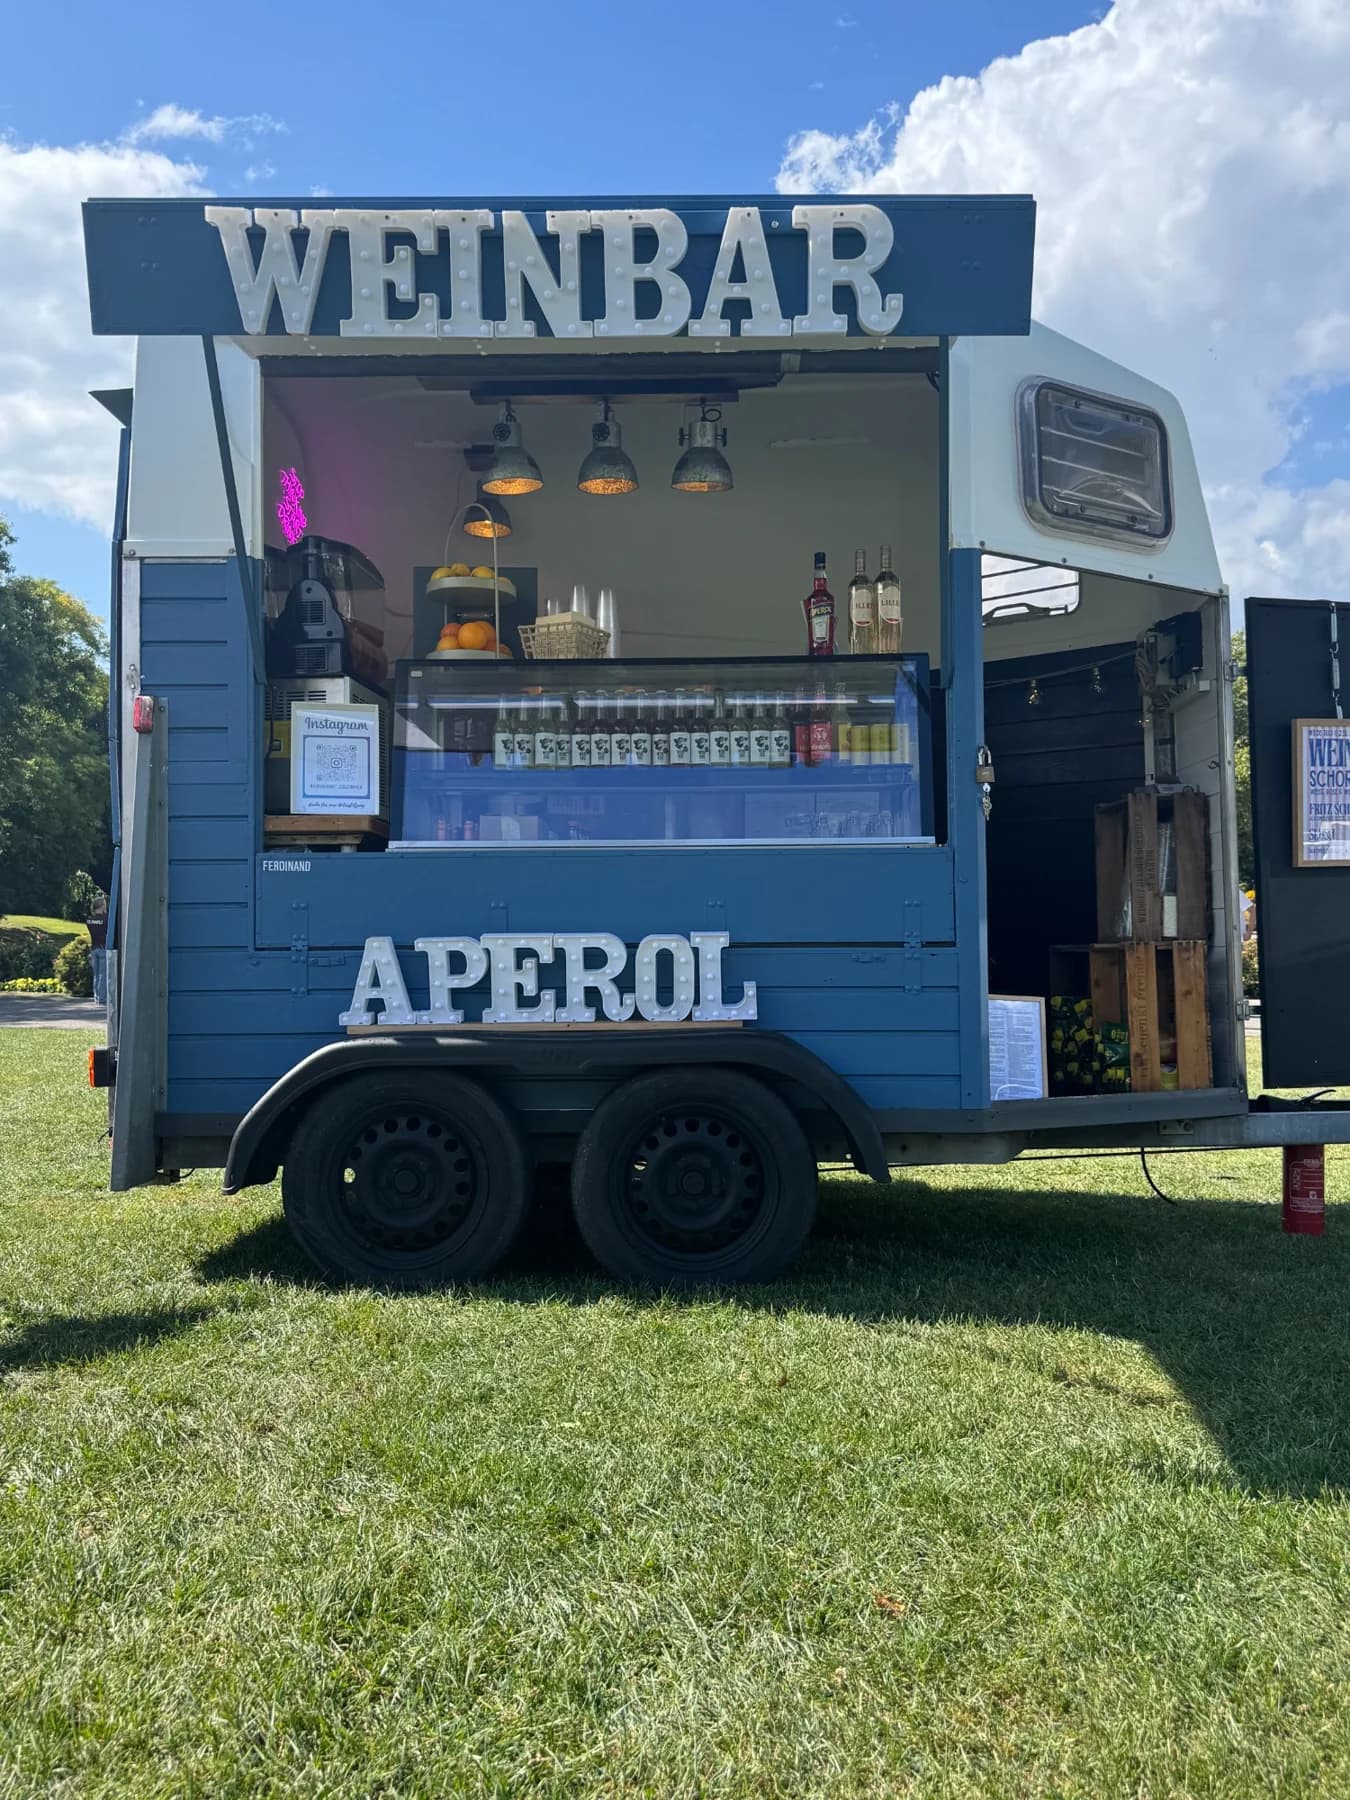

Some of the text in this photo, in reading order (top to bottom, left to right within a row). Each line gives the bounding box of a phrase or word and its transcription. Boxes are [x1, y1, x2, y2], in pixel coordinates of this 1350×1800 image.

[204, 204, 904, 338] WEINBAR
[304, 716, 368, 735] Instagram
[1309, 803, 1332, 816] FRITZ
[262, 860, 311, 872] FERDINAND
[339, 931, 758, 1026] APEROL
